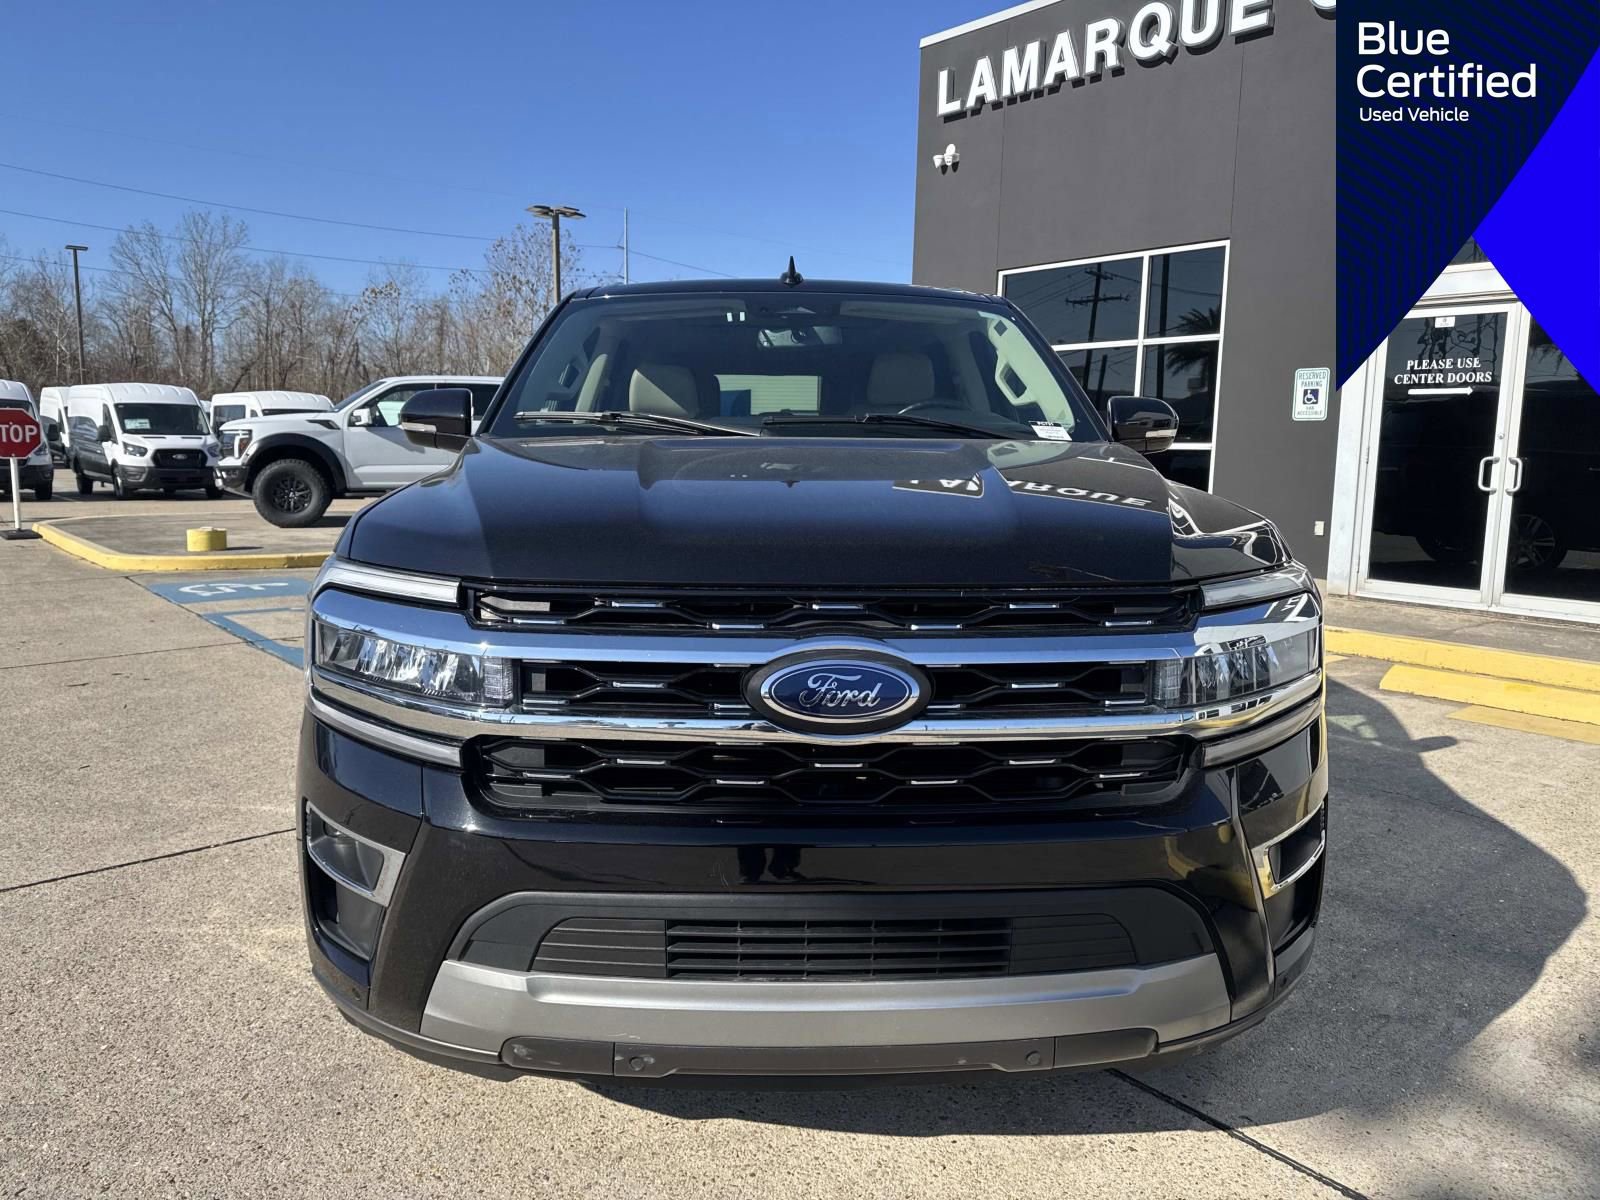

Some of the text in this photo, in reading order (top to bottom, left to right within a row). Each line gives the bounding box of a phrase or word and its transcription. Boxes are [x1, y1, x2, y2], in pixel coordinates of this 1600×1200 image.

[1406, 357, 1482, 371] PLEASE USE
[1298, 371, 1327, 380] RESERVED
[1394, 371, 1493, 385] CENTER DOORS
[1301, 380, 1323, 388] PARKING
[0, 424, 38, 443] TOP
[799, 673, 883, 707] Ford
